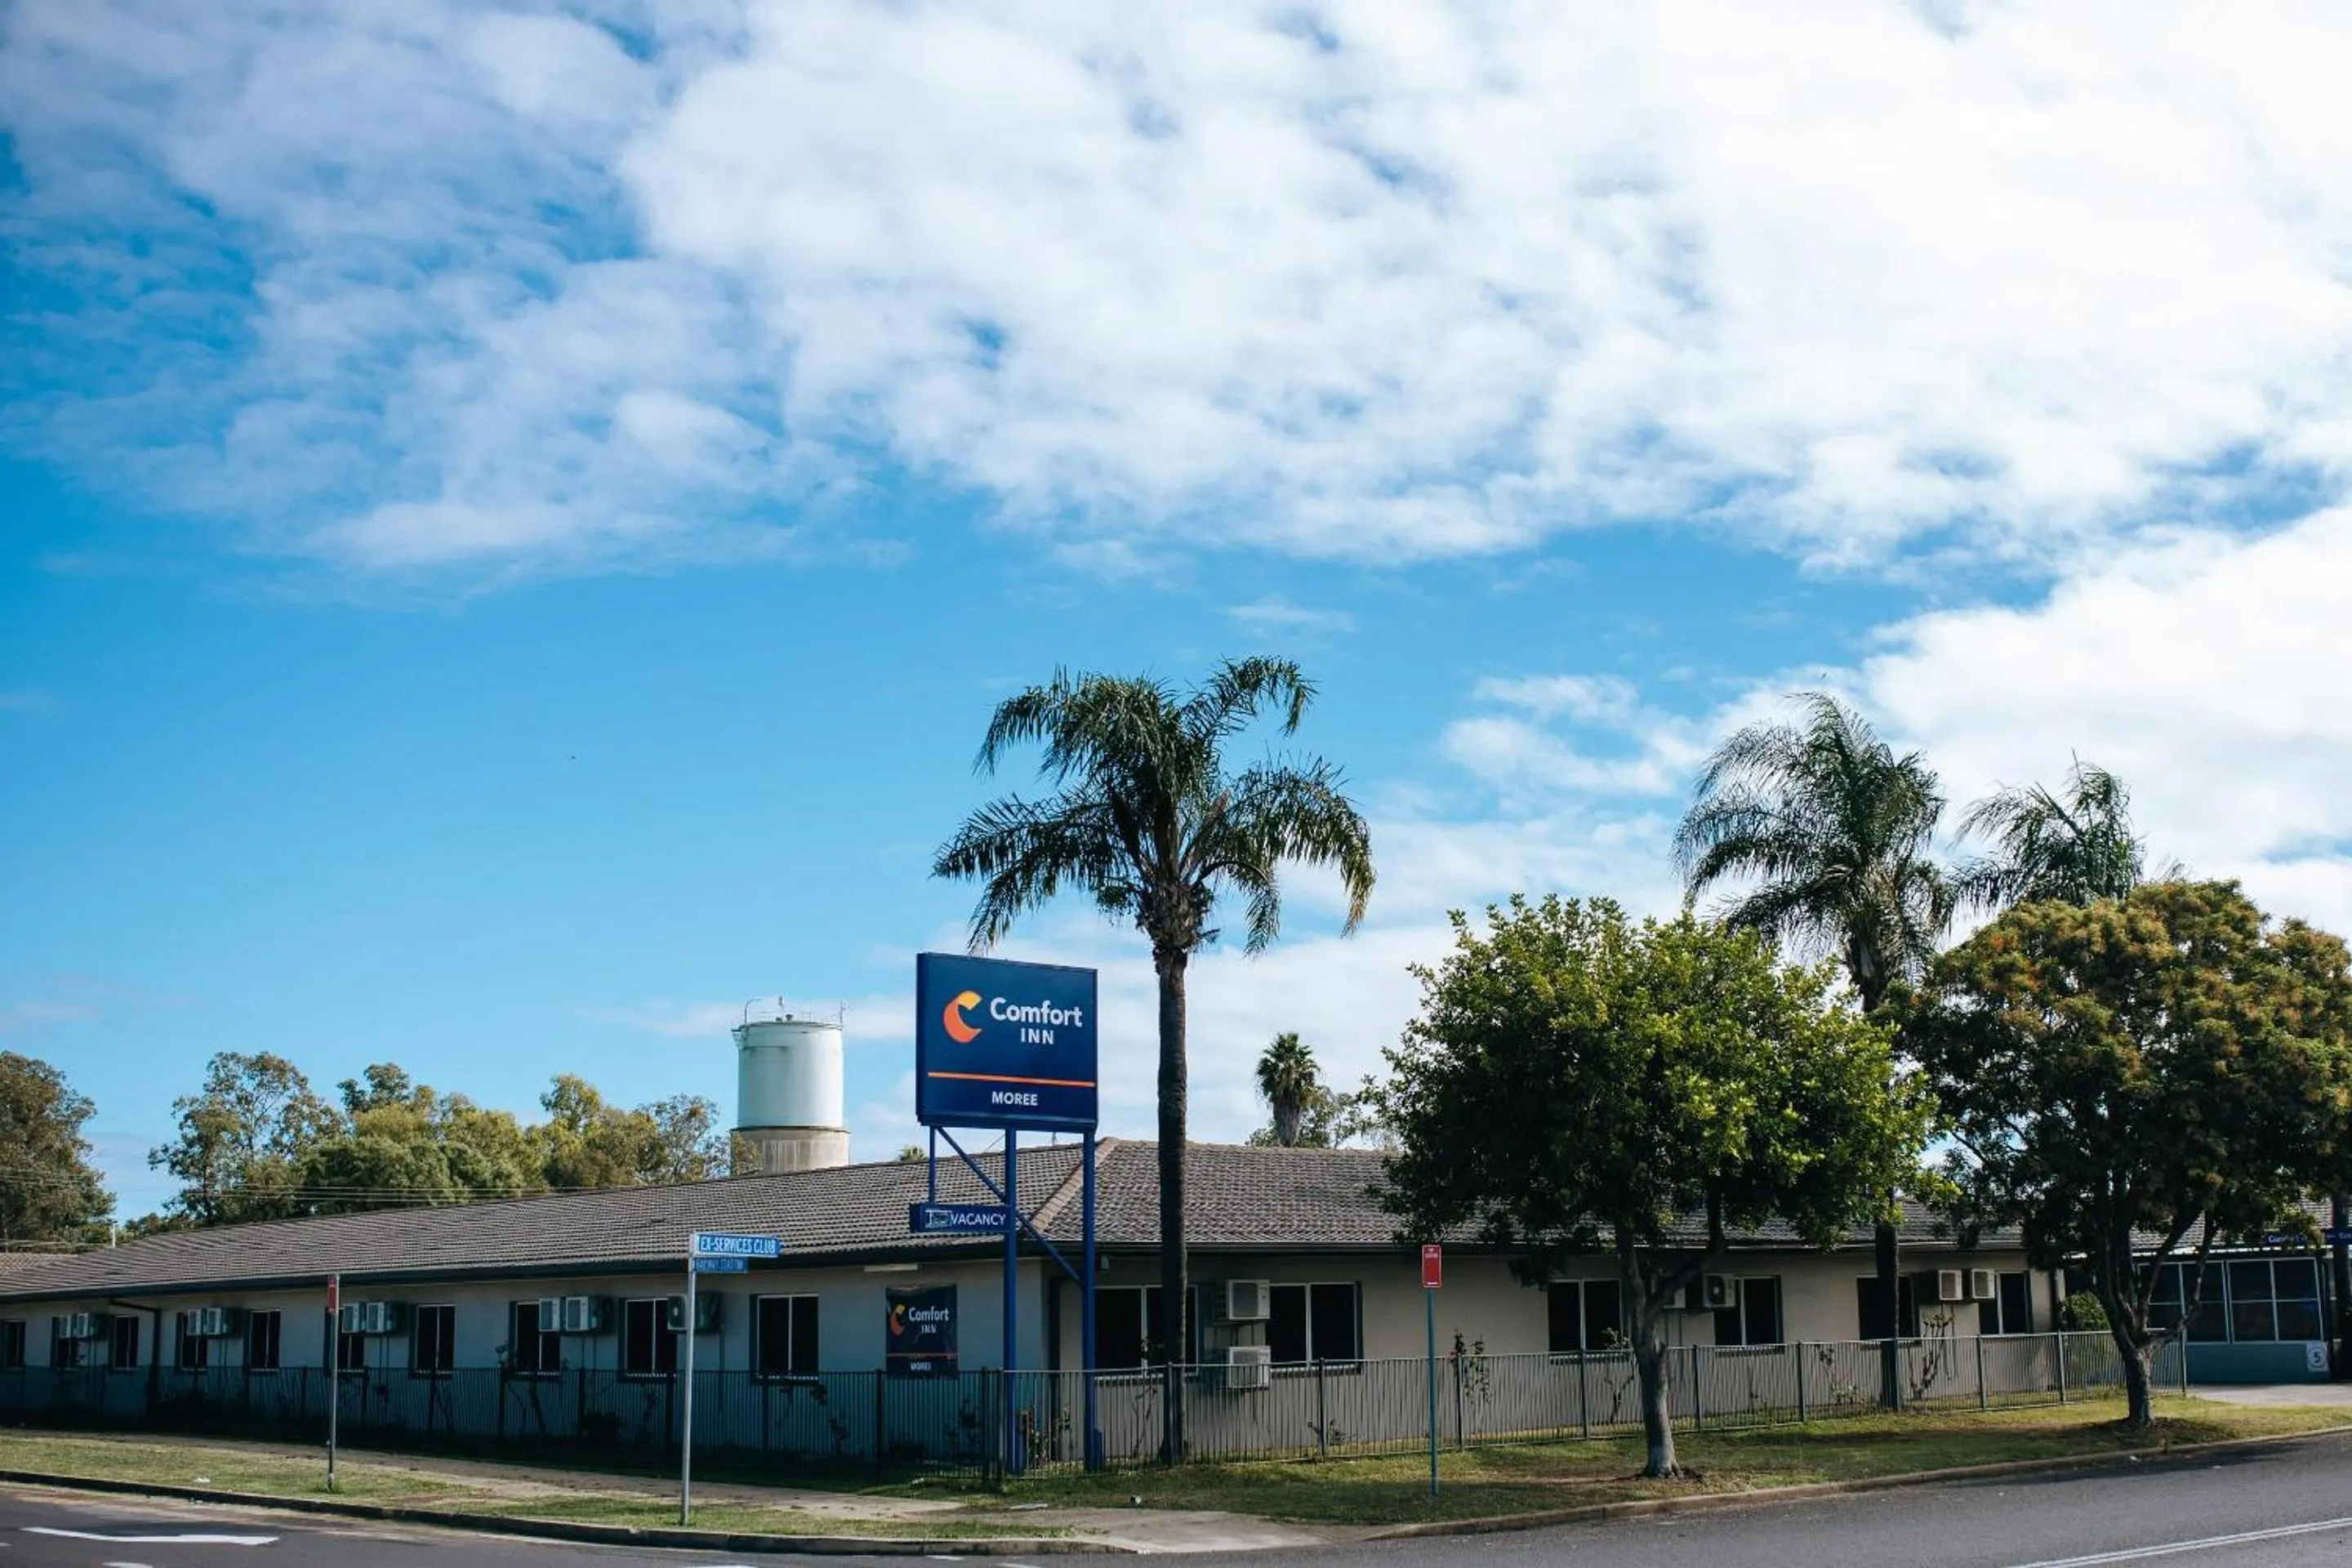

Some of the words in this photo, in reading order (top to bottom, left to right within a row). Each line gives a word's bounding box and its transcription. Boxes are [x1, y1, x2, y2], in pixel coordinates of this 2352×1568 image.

[990, 996, 1083, 1027] Comfort
[1021, 1028, 1054, 1045] INN
[991, 1091, 1038, 1106] MOREE
[951, 1213, 1006, 1226] VACANCY
[754, 1239, 776, 1254] CLUB
[908, 1306, 949, 1321] Comfort
[2314, 1351, 2322, 1364] 5
